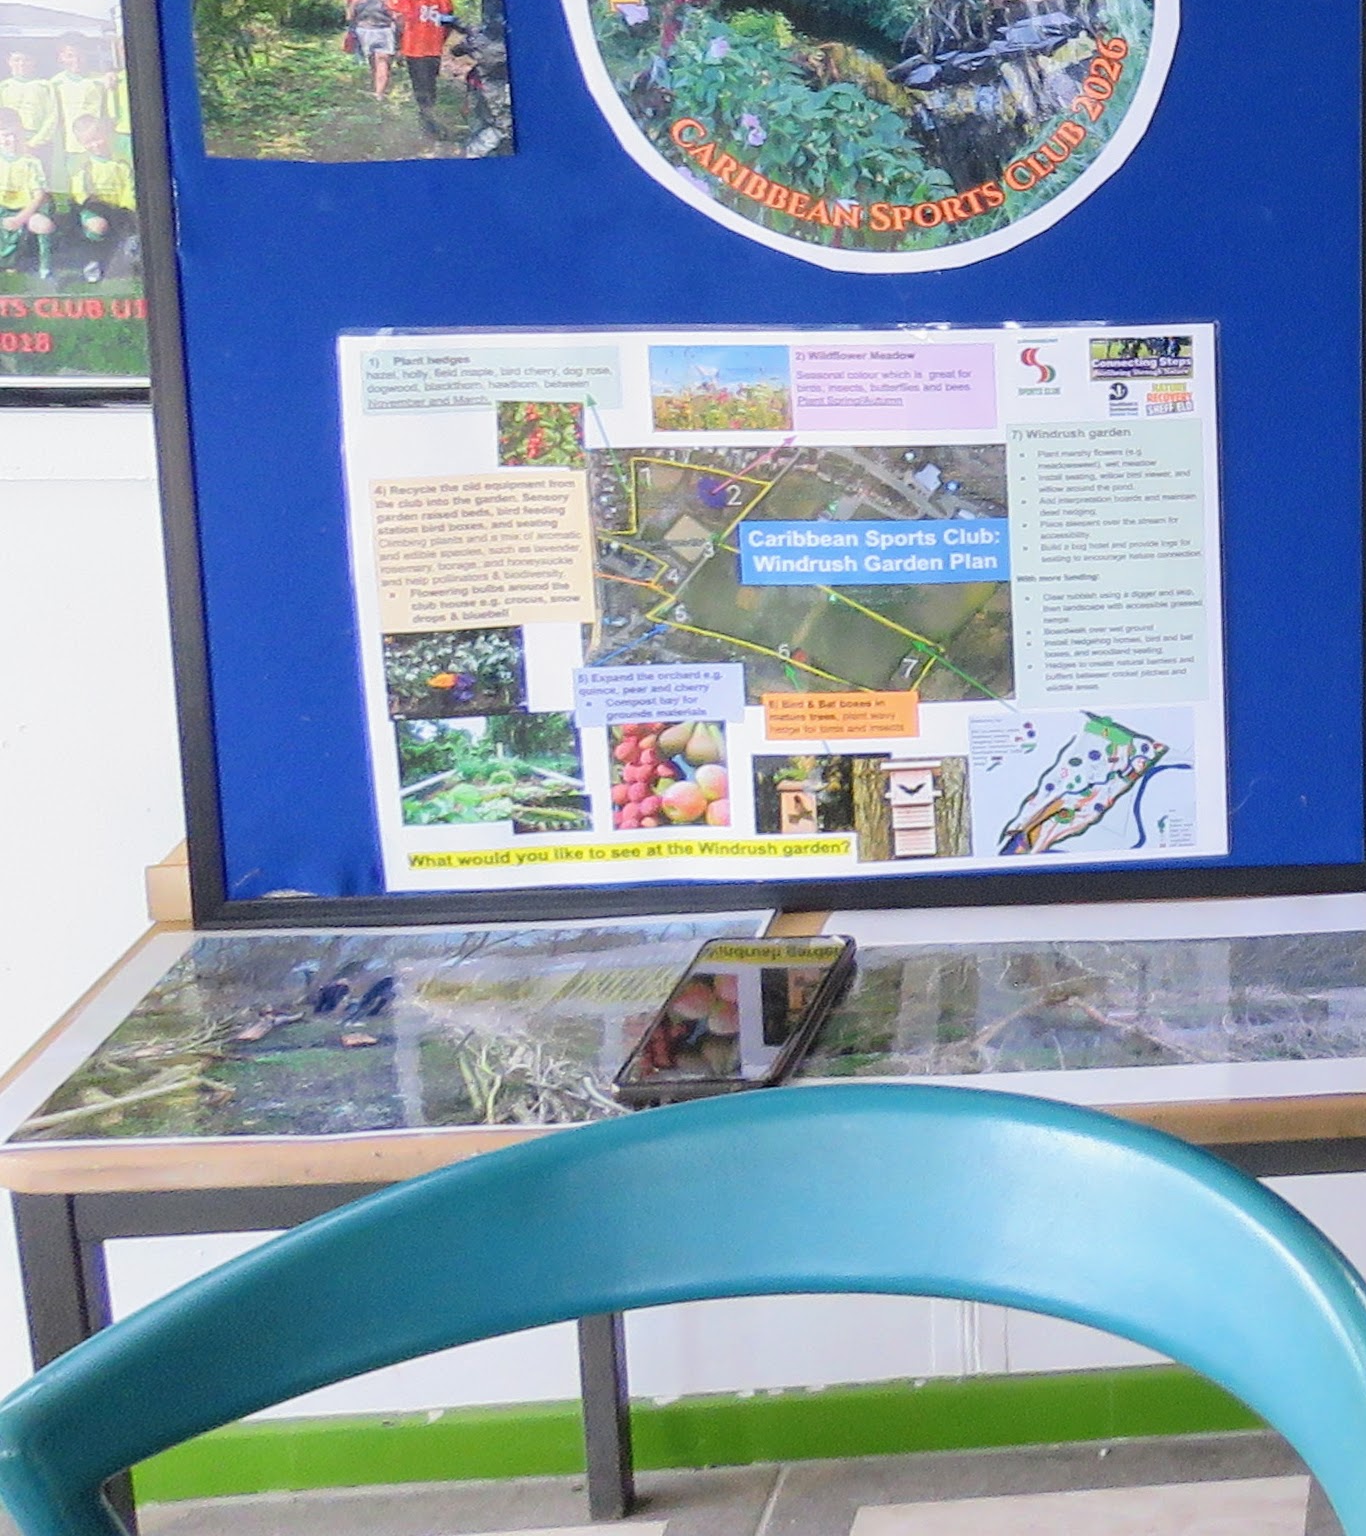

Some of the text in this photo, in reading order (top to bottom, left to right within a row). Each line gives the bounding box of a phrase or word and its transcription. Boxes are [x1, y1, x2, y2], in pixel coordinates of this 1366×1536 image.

[669, 37, 1129, 233] CARIBBEAN SPORTS CLUB 2026
[34, 297, 105, 319] CLUB
[0, 331, 52, 353] 018
[393, 356, 423, 367] Plant
[809, 351, 867, 360] Wildflower
[870, 350, 915, 360] Meadow
[1092, 356, 1192, 370] Connecting Steps
[923, 383, 942, 392] and
[1011, 428, 1132, 442] 7) Windrush garden
[390, 485, 437, 496] Recycle
[440, 483, 459, 493] the
[462, 482, 480, 491] old
[484, 480, 546, 492] equipment
[727, 485, 742, 506] 2
[376, 500, 394, 509] the
[453, 496, 471, 505] the
[522, 493, 569, 504] Sensory
[376, 513, 418, 524] garden
[421, 523, 445, 533] bird
[491, 520, 513, 529] and
[749, 527, 1000, 550] Caribbean Sports Club:
[753, 552, 998, 573] Windrush Garden Plan
[902, 659, 918, 678] 7
[591, 672, 634, 685] Expand
[637, 671, 655, 682] the
[657, 670, 701, 682] orchard
[703, 671, 723, 683] e.g.
[622, 684, 648, 696] pear
[651, 682, 671, 694] and
[674, 681, 709, 694] cherry
[606, 695, 698, 709] Compost bay for
[840, 699, 872, 709] boxes
[607, 706, 707, 721] grounds materials
[410, 839, 851, 868] What would you like to see at the Windrush garden?
